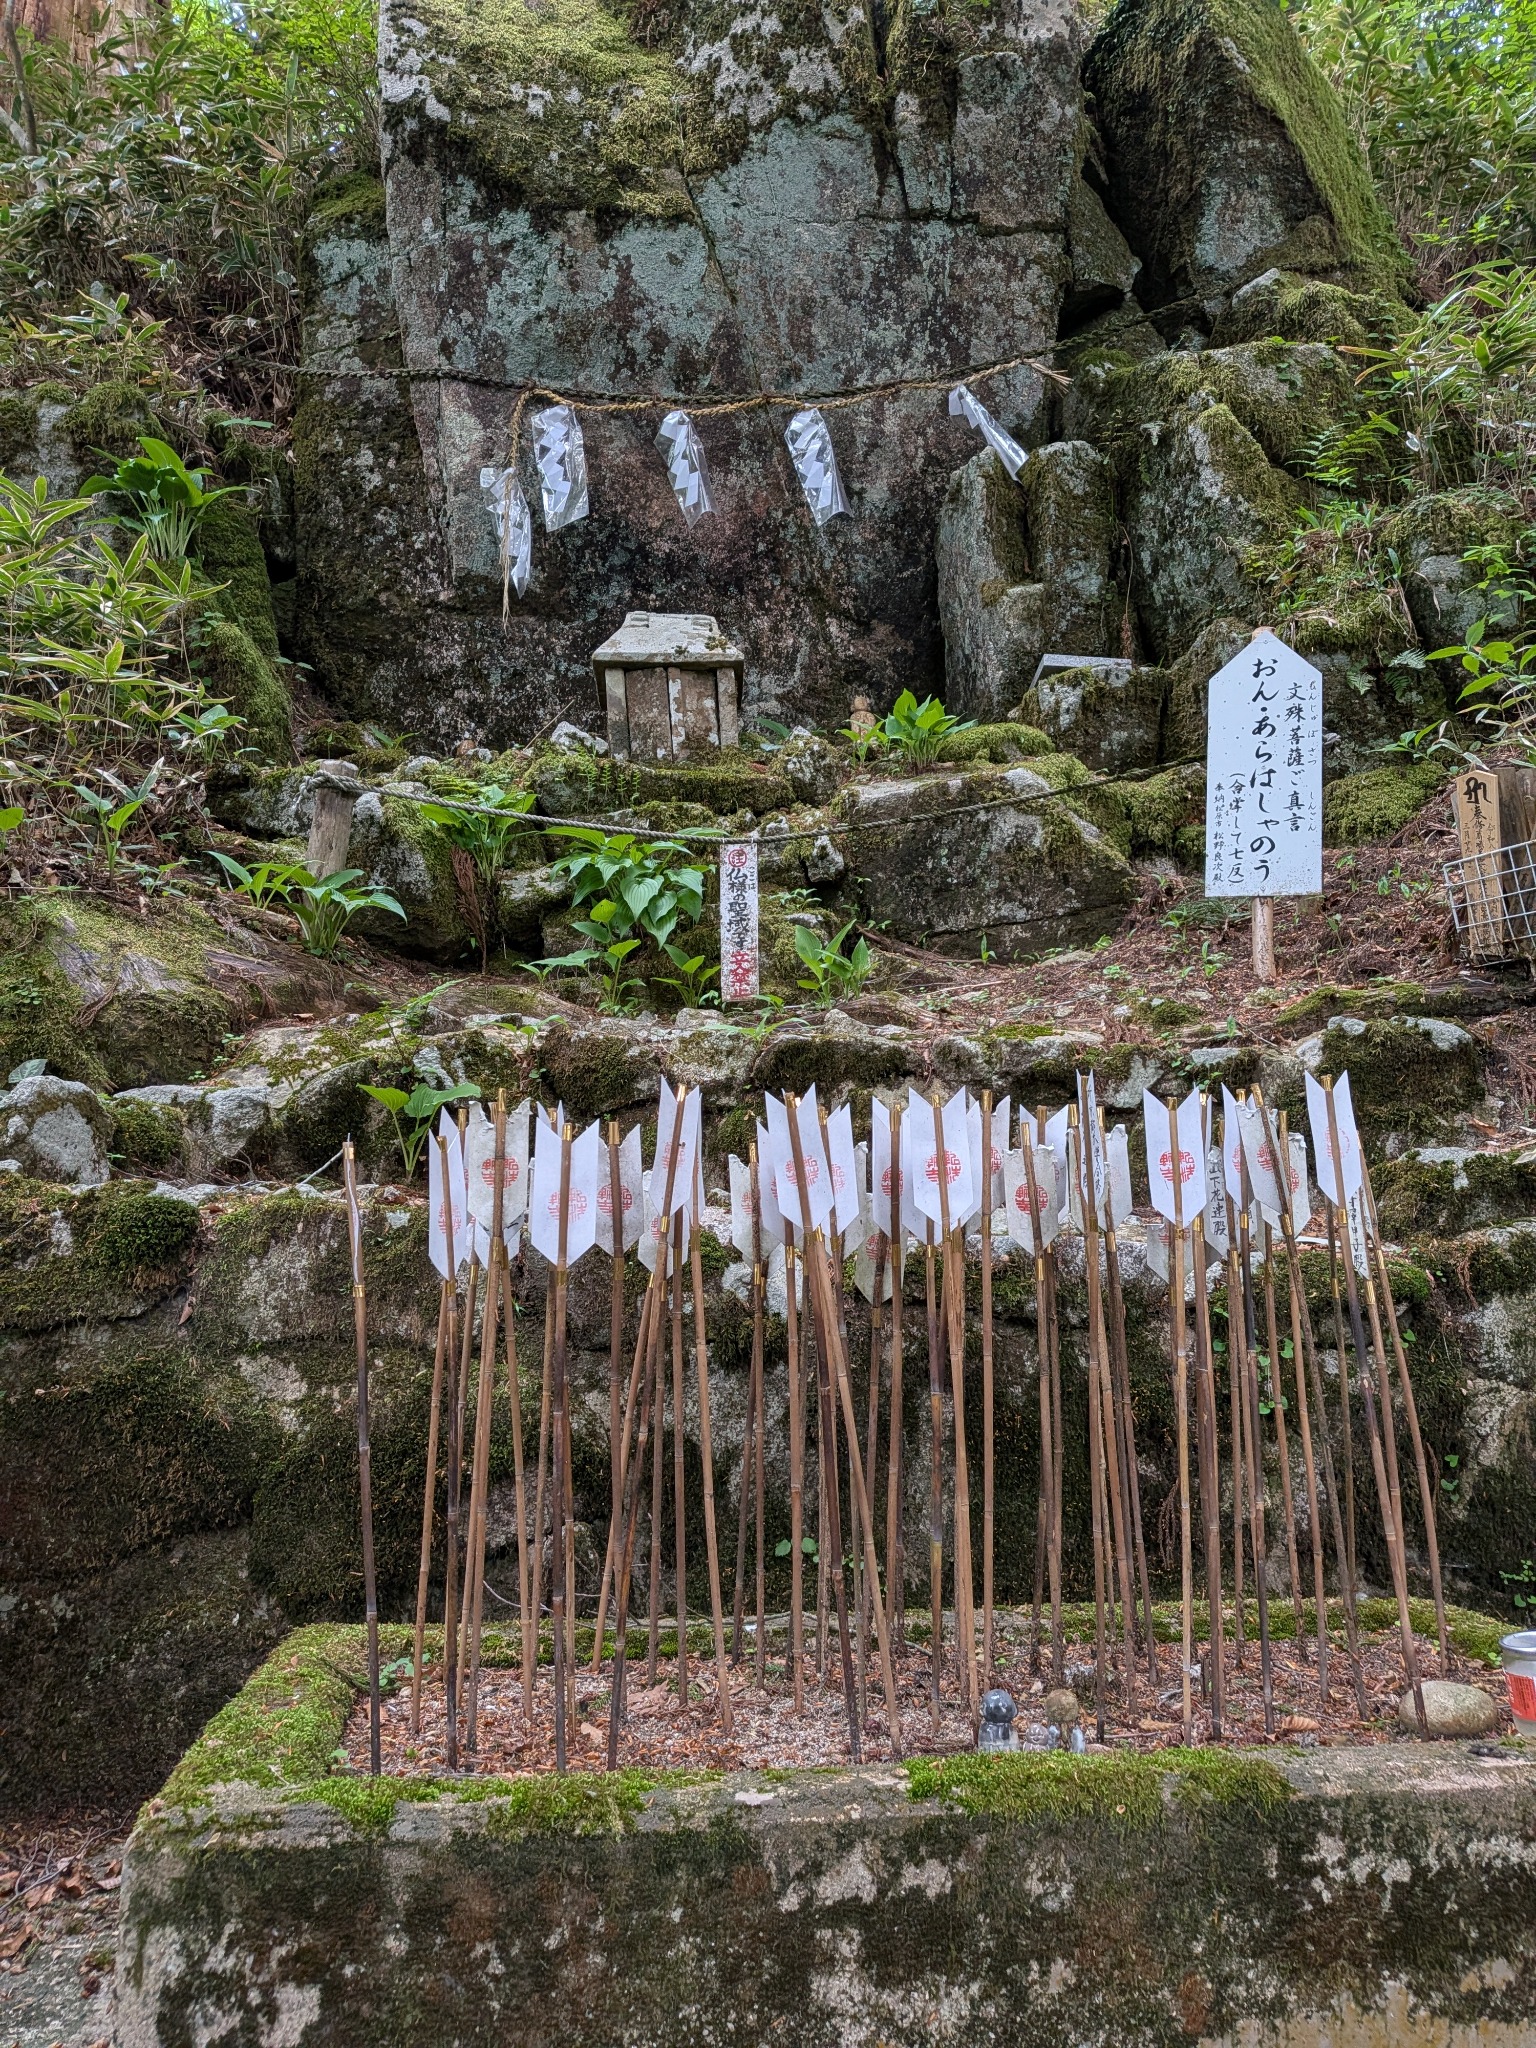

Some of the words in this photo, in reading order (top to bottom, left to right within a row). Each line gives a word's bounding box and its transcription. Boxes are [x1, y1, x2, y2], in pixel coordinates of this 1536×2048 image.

[1283, 682, 1306, 832] 文殊菩薩ご真言
[1307, 791, 1318, 832] しんごん
[730, 950, 752, 998] 立入禁止
